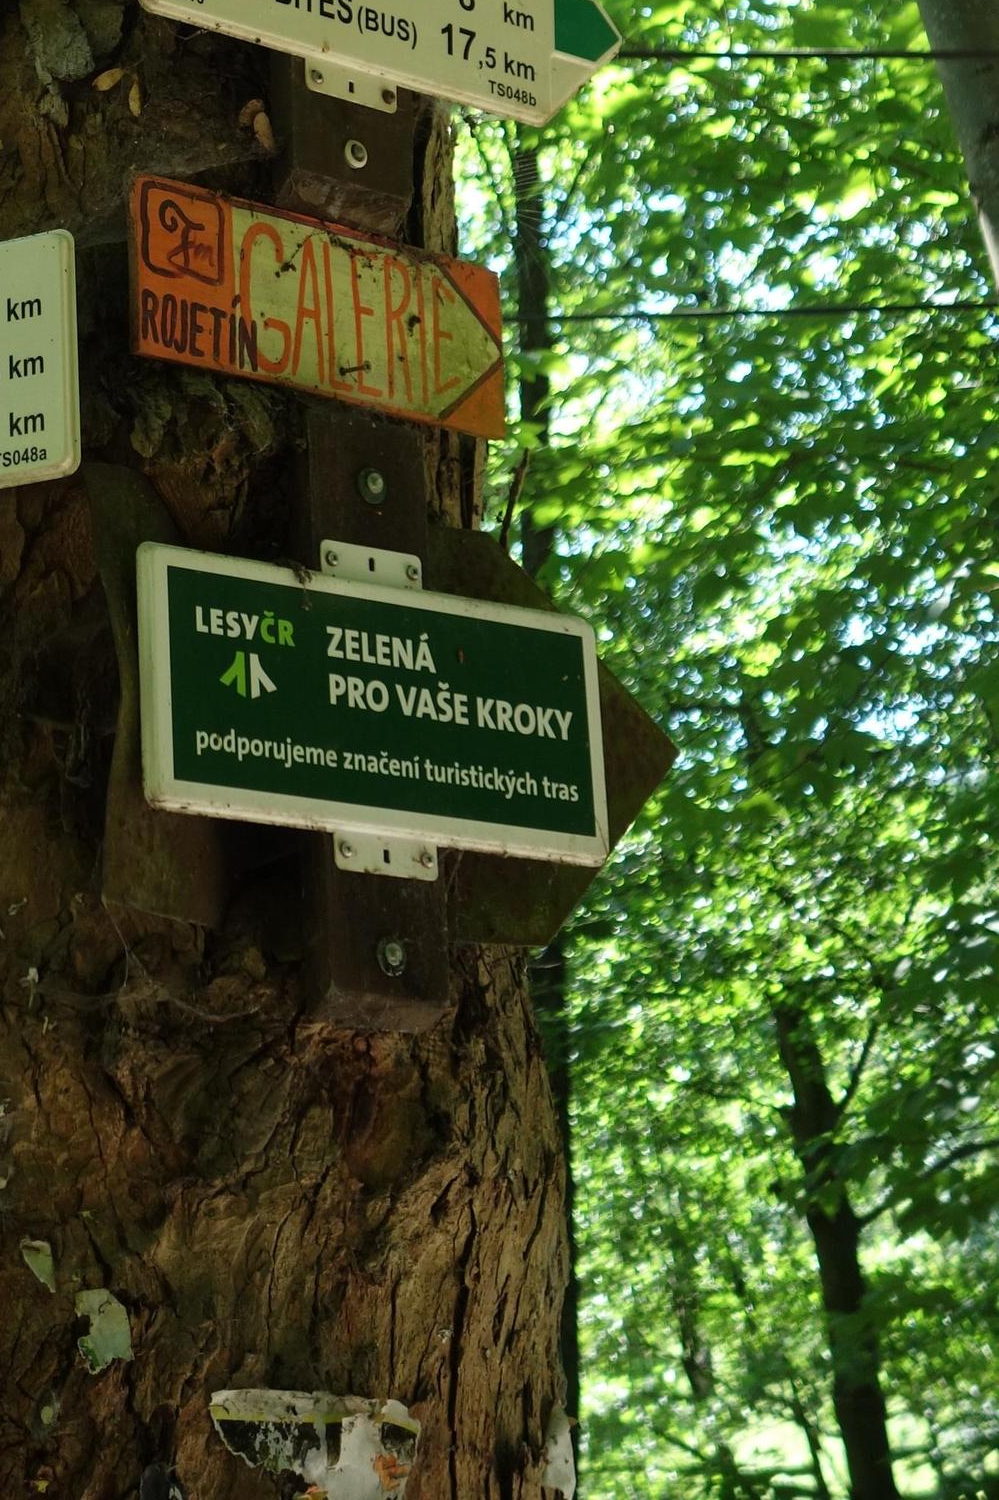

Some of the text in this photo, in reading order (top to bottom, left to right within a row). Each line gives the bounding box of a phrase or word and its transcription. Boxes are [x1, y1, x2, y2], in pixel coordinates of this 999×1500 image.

[502, 0, 535, 31] km
[440, 24, 497, 71] 17,5
[504, 51, 535, 82] km
[487, 79, 537, 107] TS048b
[6, 295, 42, 322] km
[141, 289, 258, 372] ROJETÍN
[239, 221, 461, 405] GALERIE
[8, 354, 45, 380] km
[9, 412, 45, 438] km
[326, 625, 437, 675] ZELENÁ
[328, 674, 573, 742] PRO VAŠE KROKY
[196, 728, 579, 802] podporujeme značení turistických tras
